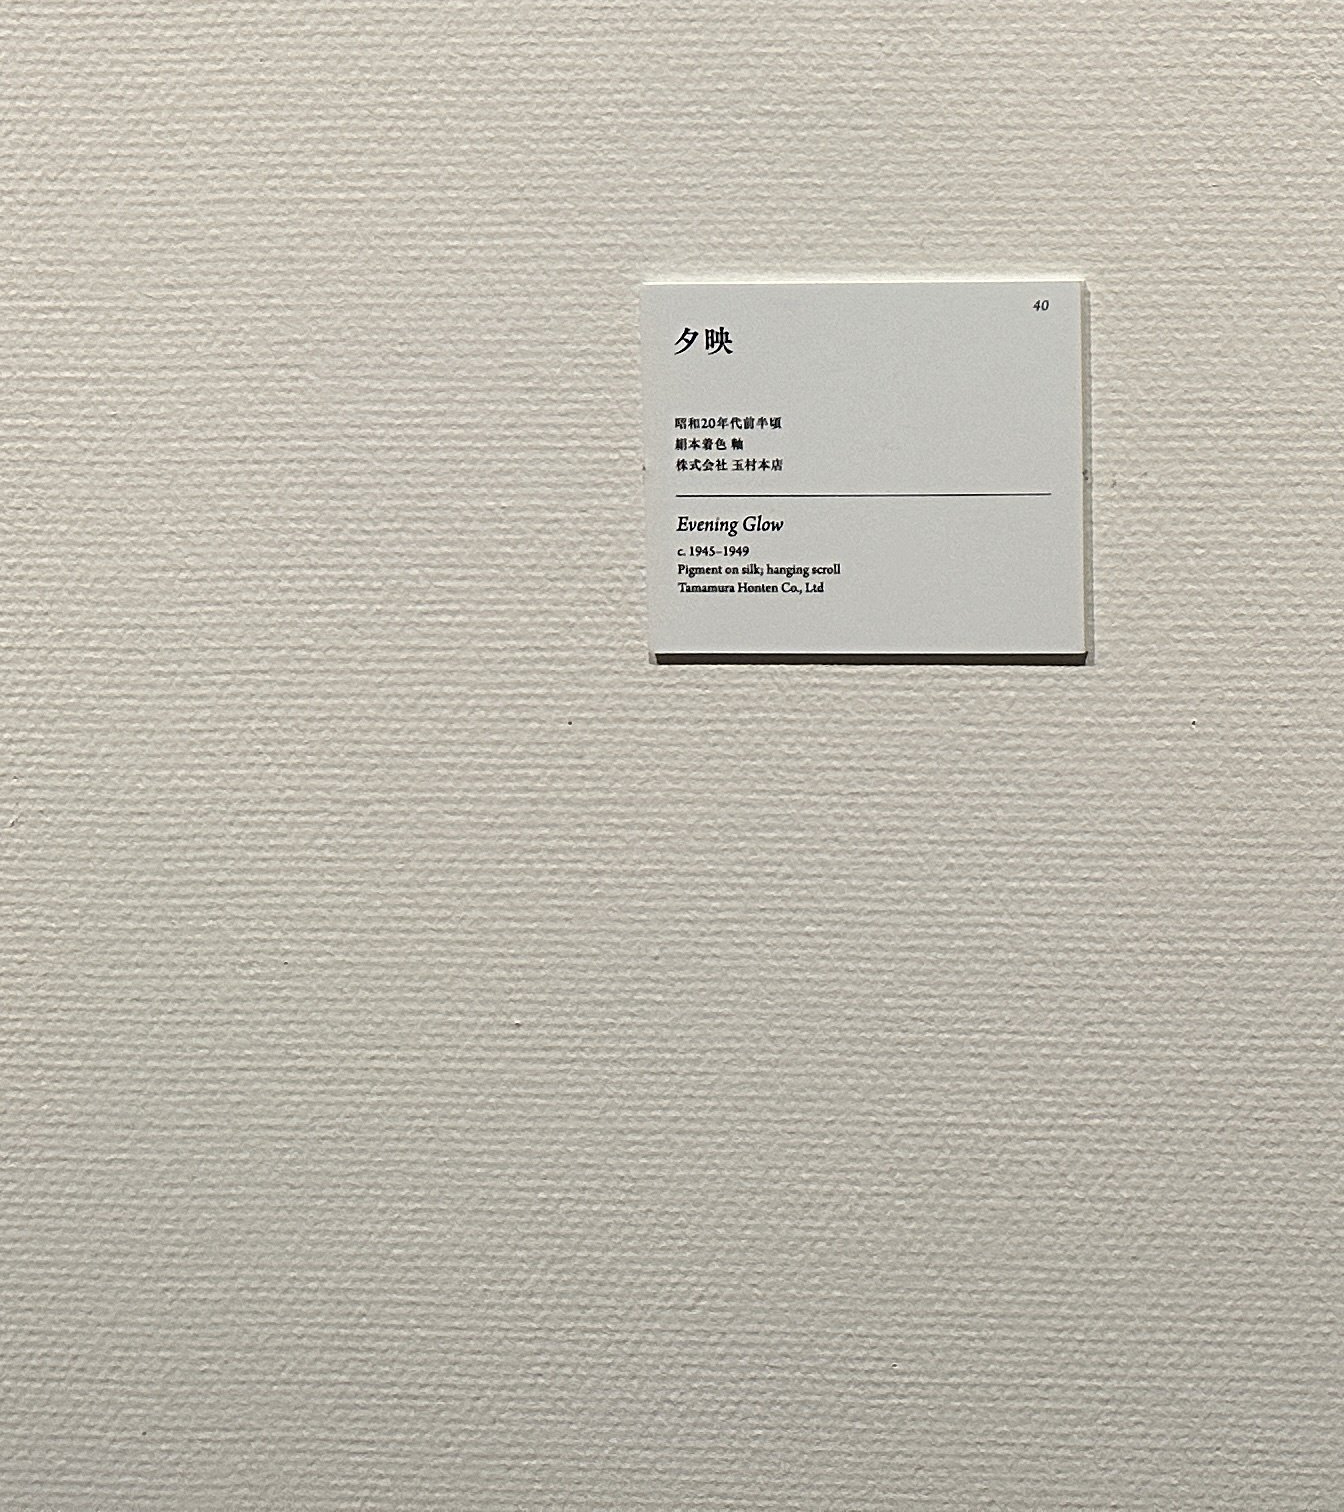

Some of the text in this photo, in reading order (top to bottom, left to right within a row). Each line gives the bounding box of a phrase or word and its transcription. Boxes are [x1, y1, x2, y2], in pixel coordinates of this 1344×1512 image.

[1032, 299, 1050, 312] 40
[673, 326, 734, 356] 夕映
[674, 415, 783, 430] 昭和20年代前半頃
[730, 437, 744, 451] 軸
[675, 457, 784, 472] 株式会社 玉村本店
[675, 514, 785, 538] Evening Glow
[676, 548, 687, 557] c.
[677, 563, 841, 579] Pigment on silk; hanging scroll
[677, 581, 825, 596] Tamamura Honten Co., Ltd
